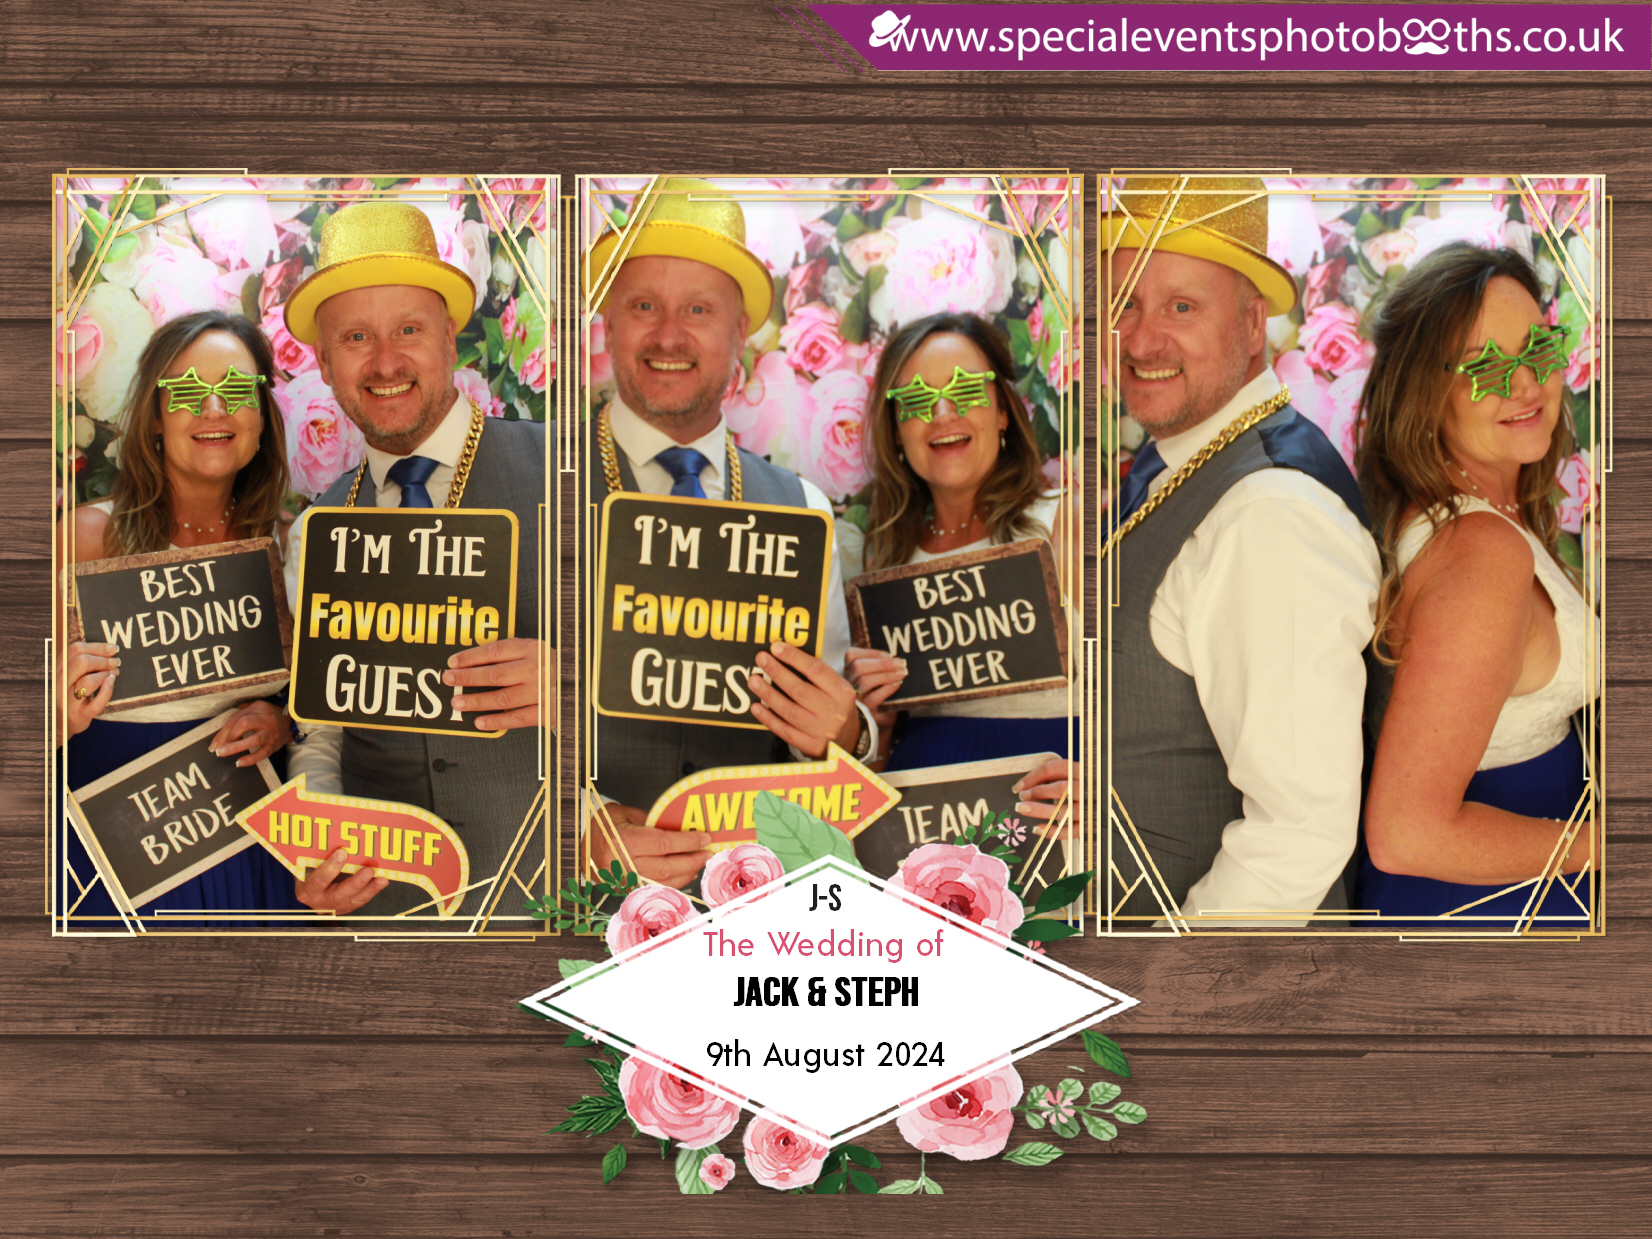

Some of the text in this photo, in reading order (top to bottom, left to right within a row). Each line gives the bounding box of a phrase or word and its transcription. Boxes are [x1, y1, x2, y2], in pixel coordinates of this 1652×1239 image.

[409, 519, 486, 577] THE
[719, 514, 799, 578] THE
[139, 560, 216, 602] BEST
[913, 565, 986, 610] BEST
[100, 595, 262, 649] WEDDING
[309, 593, 500, 646] Favourite
[612, 584, 810, 647] Favourite
[882, 599, 1036, 657] WEDDING
[152, 645, 236, 688] EVER
[928, 650, 1011, 691] EVER
[127, 762, 211, 822] TEAM
[140, 792, 237, 865] BRIDE
[269, 810, 443, 866] HOT STUFF
[897, 798, 995, 844] TEAM
